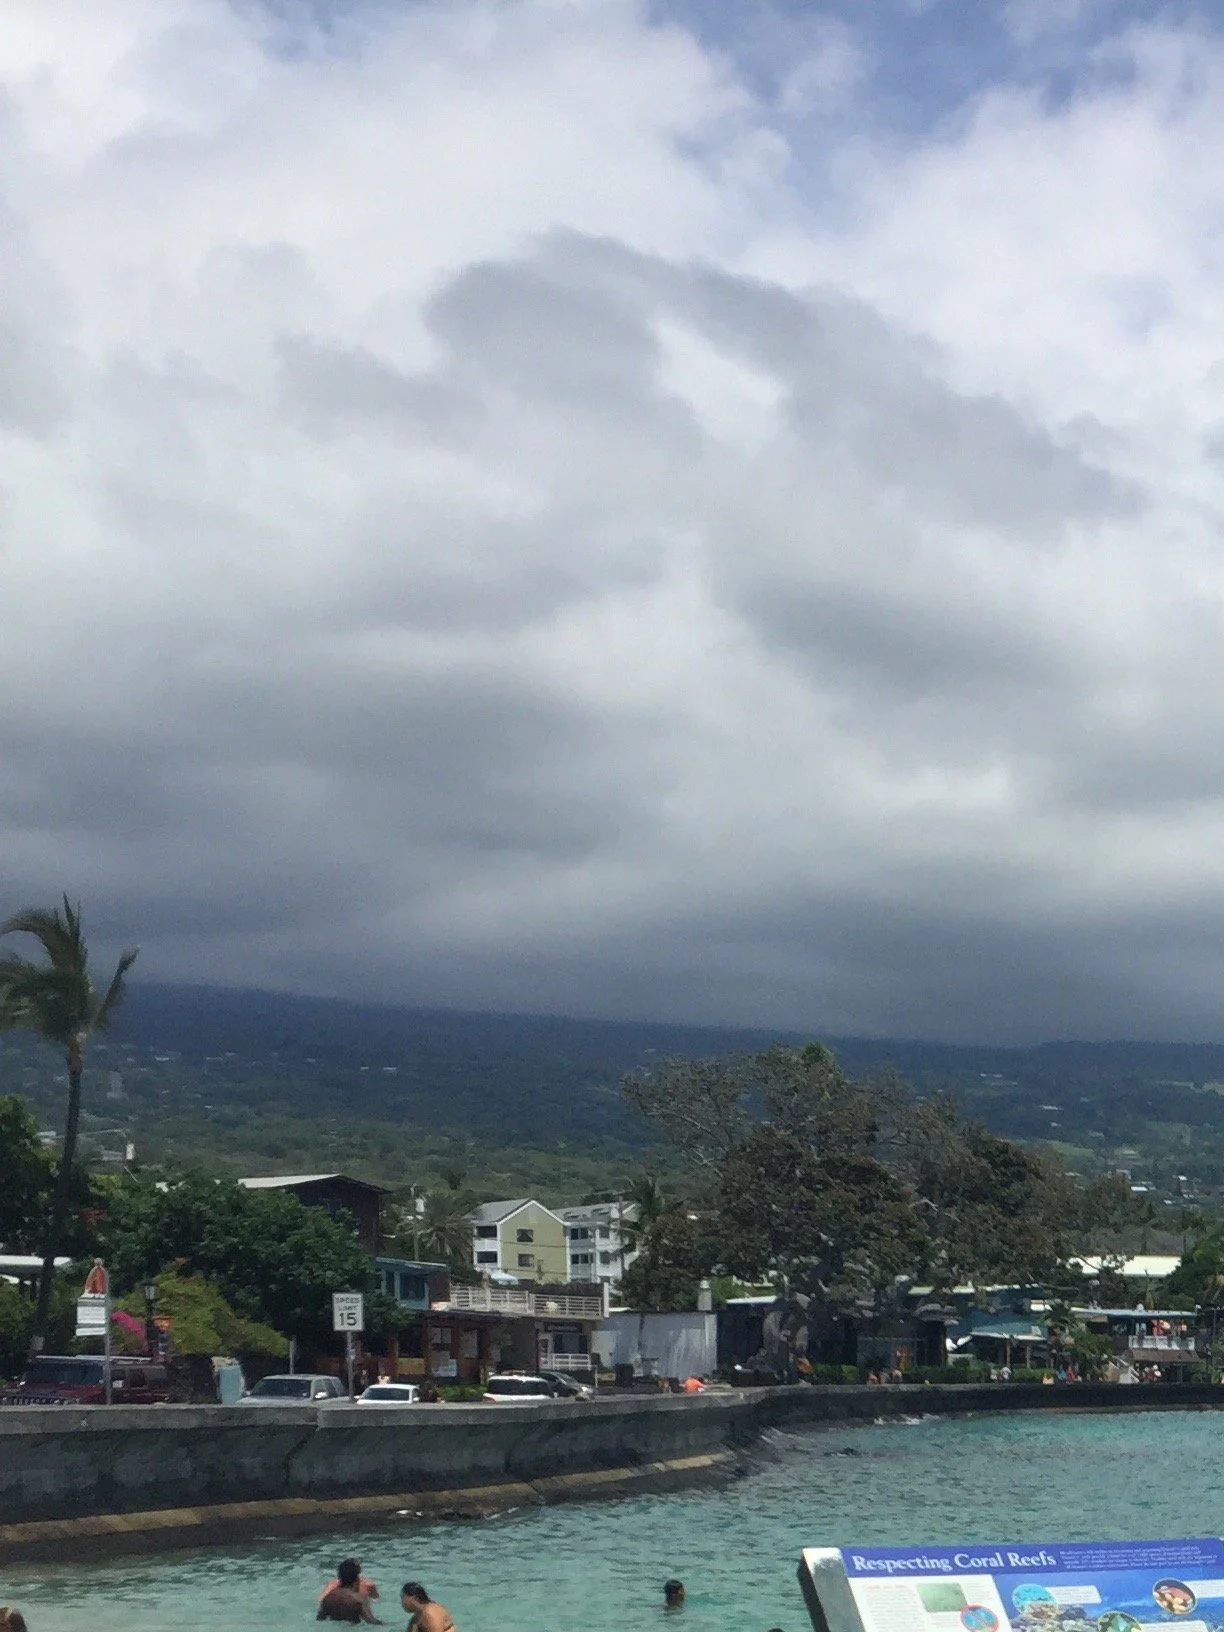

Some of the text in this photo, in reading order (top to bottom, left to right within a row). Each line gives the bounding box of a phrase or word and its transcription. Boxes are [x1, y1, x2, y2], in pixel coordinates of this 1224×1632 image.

[339, 1312, 357, 1326] 15
[852, 1554, 954, 1573] Respecting
[954, 1552, 1005, 1569] Coral
[1006, 1550, 1056, 1567] Reefs
